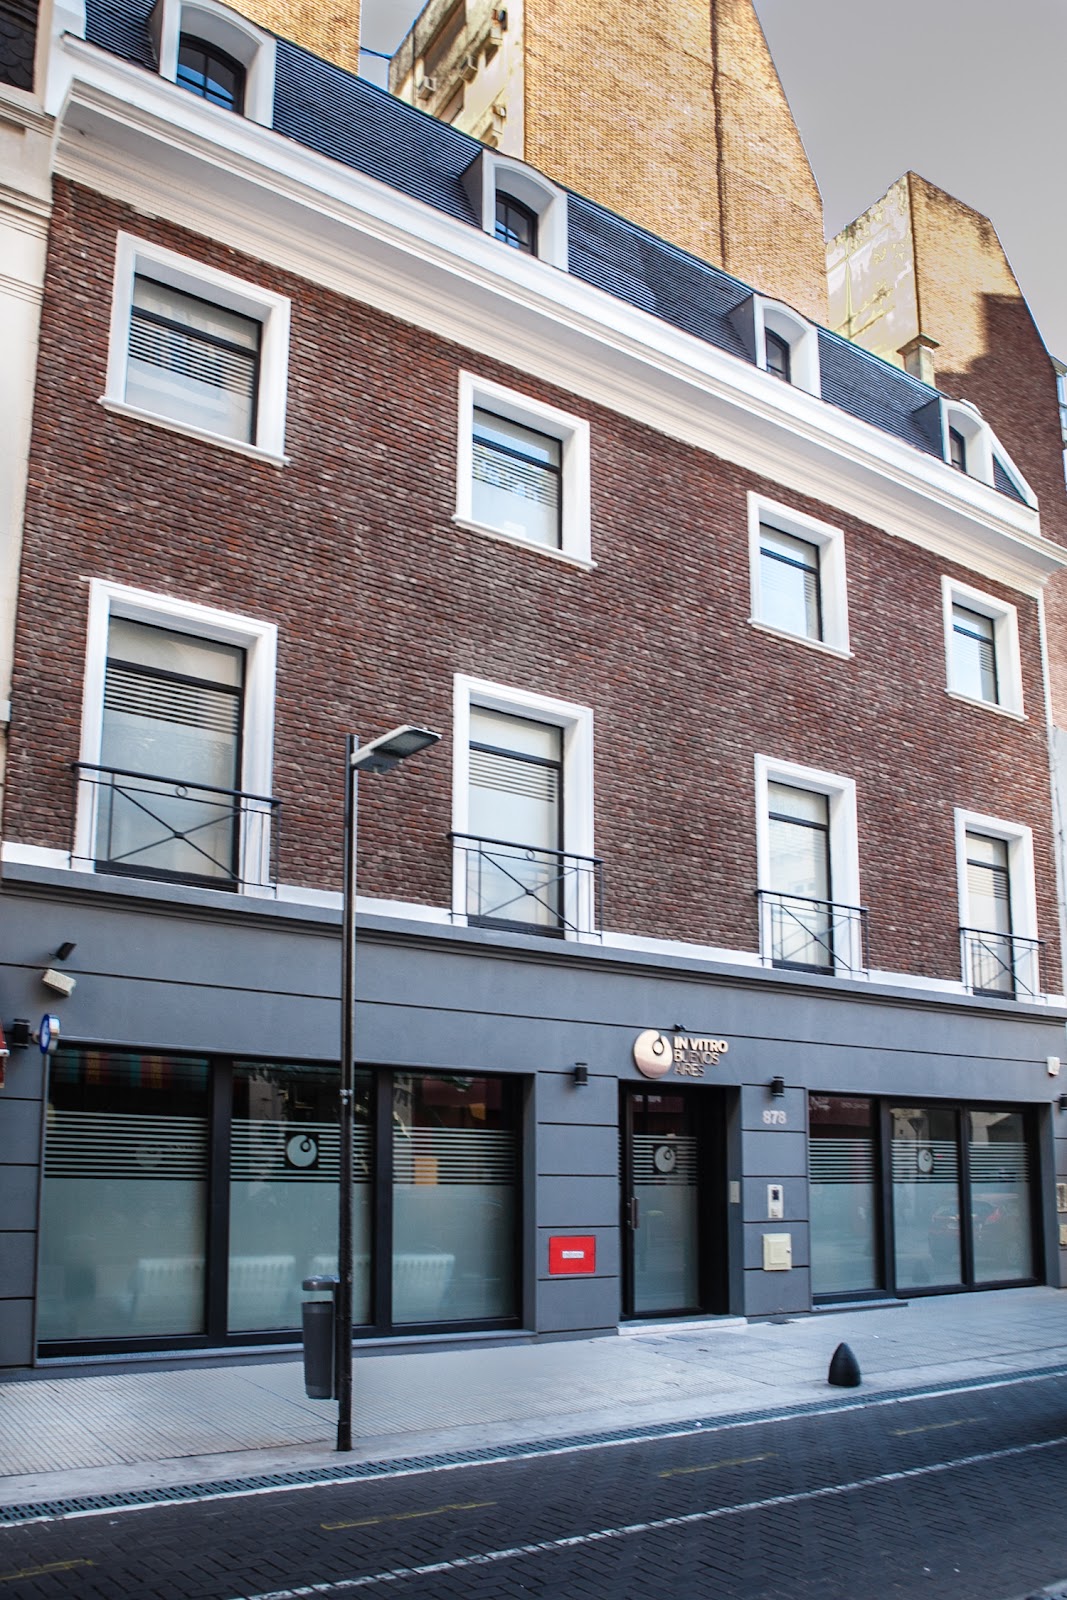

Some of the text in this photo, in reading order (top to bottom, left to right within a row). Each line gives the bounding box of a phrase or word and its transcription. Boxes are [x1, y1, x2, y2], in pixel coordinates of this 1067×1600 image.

[673, 1036, 729, 1053] IN VITRO
[673, 1049, 720, 1065] BUENOS
[673, 1062, 705, 1077] AIRES
[762, 1110, 787, 1125] 878
